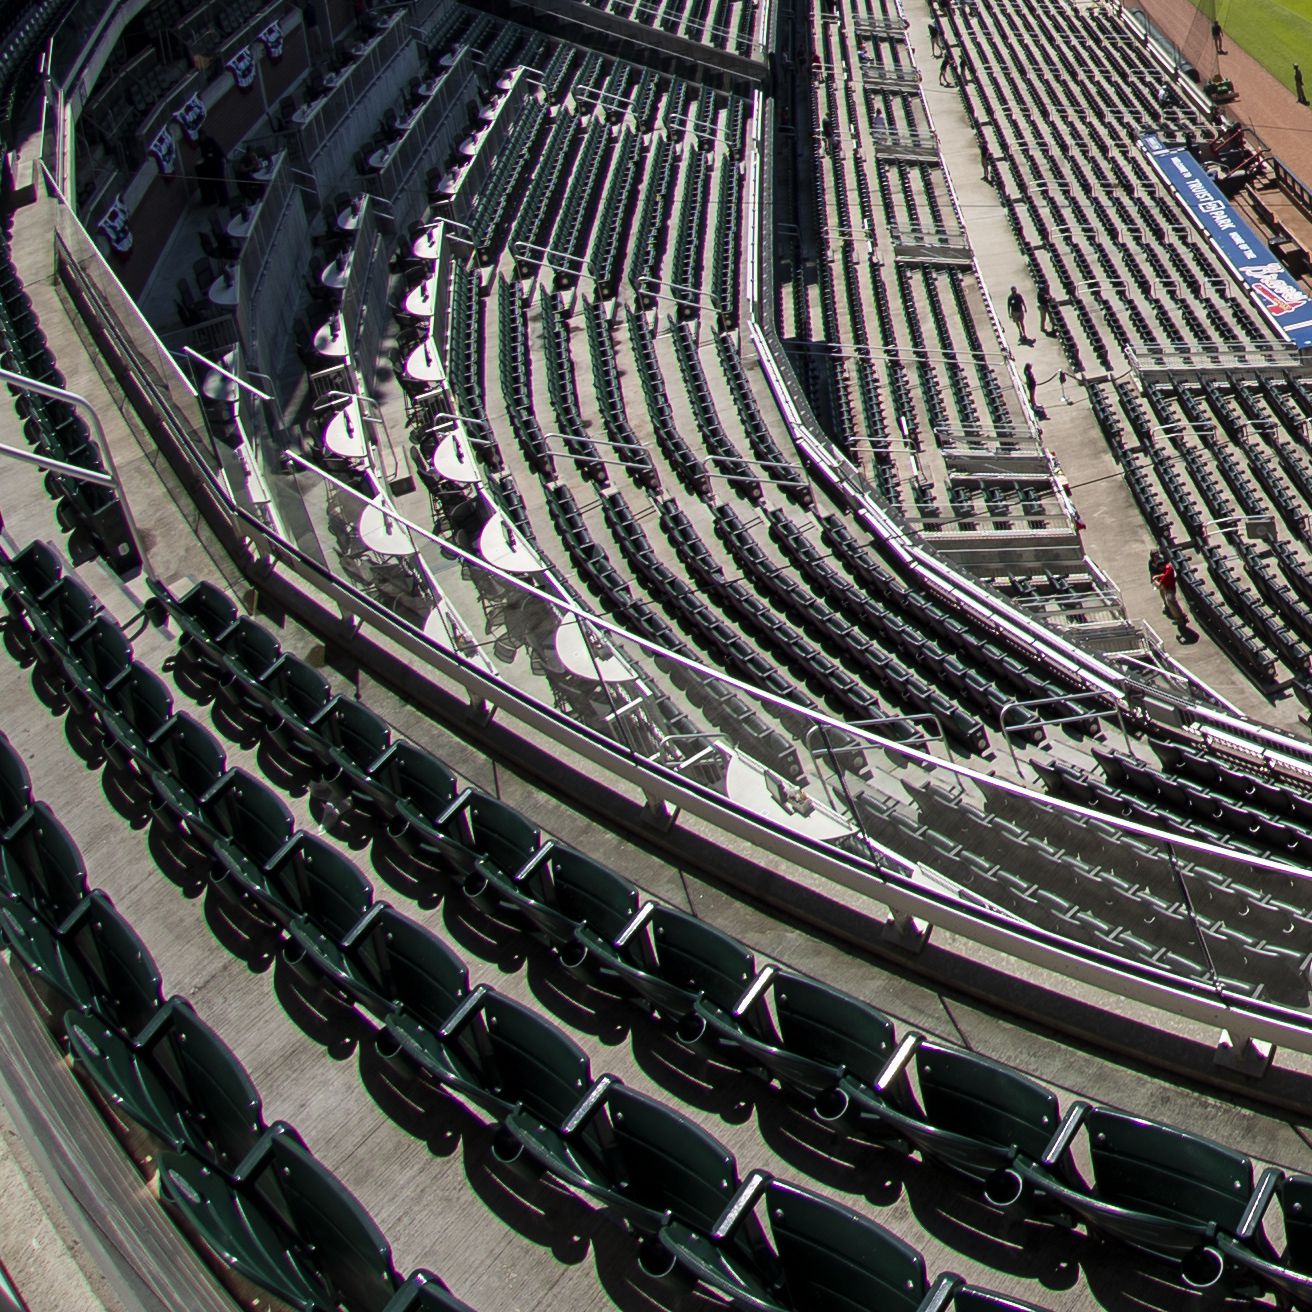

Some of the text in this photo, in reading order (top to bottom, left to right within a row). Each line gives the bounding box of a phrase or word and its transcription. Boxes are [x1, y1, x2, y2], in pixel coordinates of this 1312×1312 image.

[1186, 178, 1236, 231] TRUIST PARK
[1239, 263, 1312, 302] Braves
